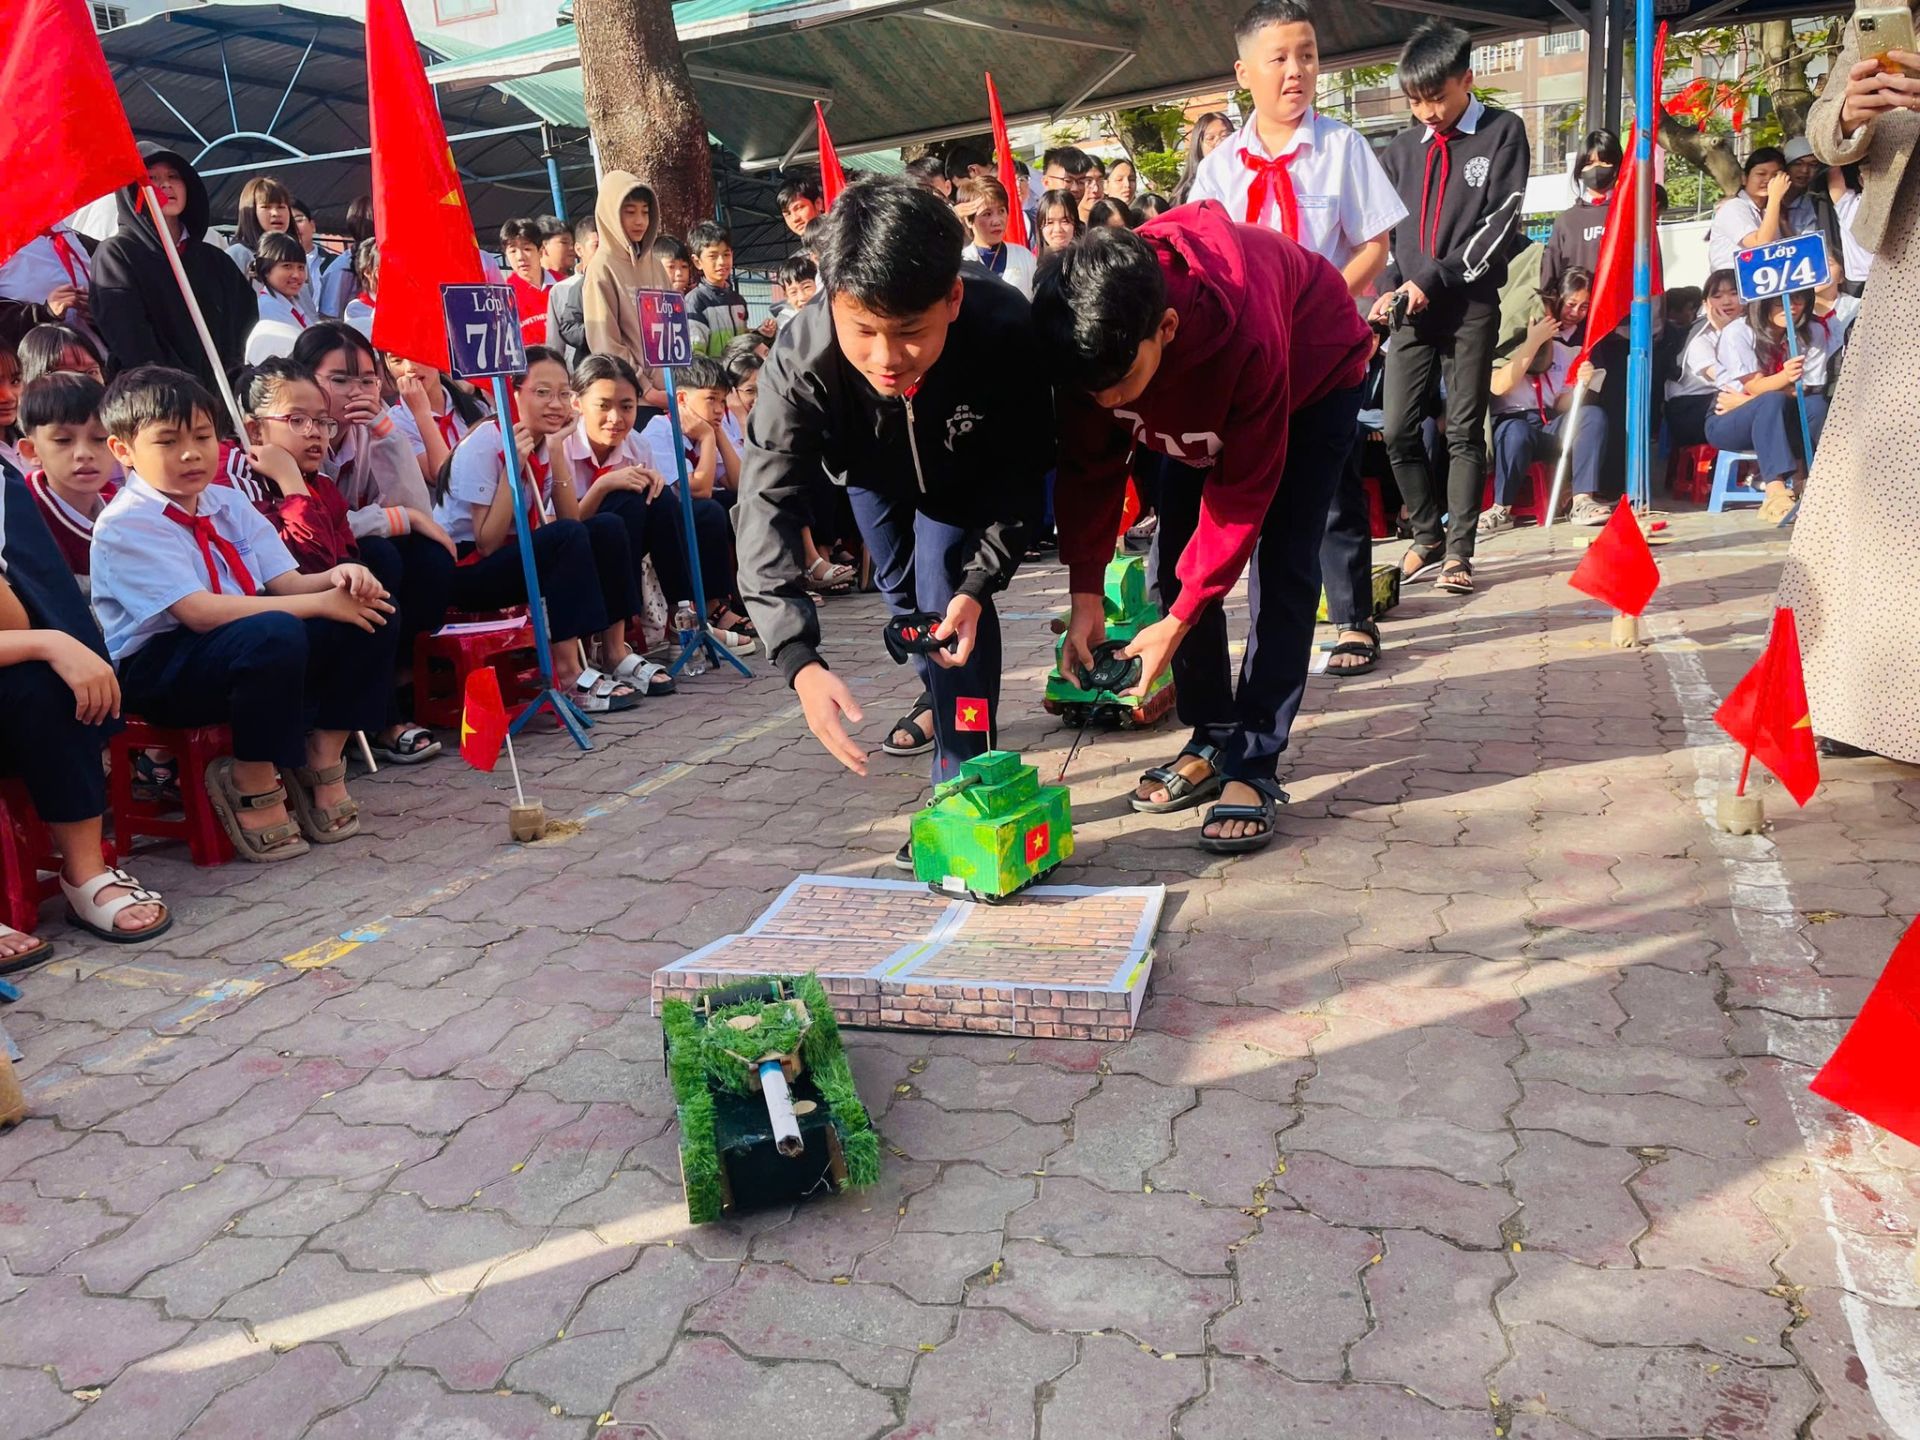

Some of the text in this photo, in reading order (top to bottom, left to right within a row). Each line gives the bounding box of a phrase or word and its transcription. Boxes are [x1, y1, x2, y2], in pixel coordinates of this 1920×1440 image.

[1584, 226, 1605, 241] UF
[1762, 245, 1797, 261] Lớp
[1752, 257, 1816, 294] 9/4
[471, 292, 503, 316] Lớp
[654, 296, 673, 318] Lớp
[465, 321, 520, 369] 7/4
[651, 321, 685, 361] 7/5
